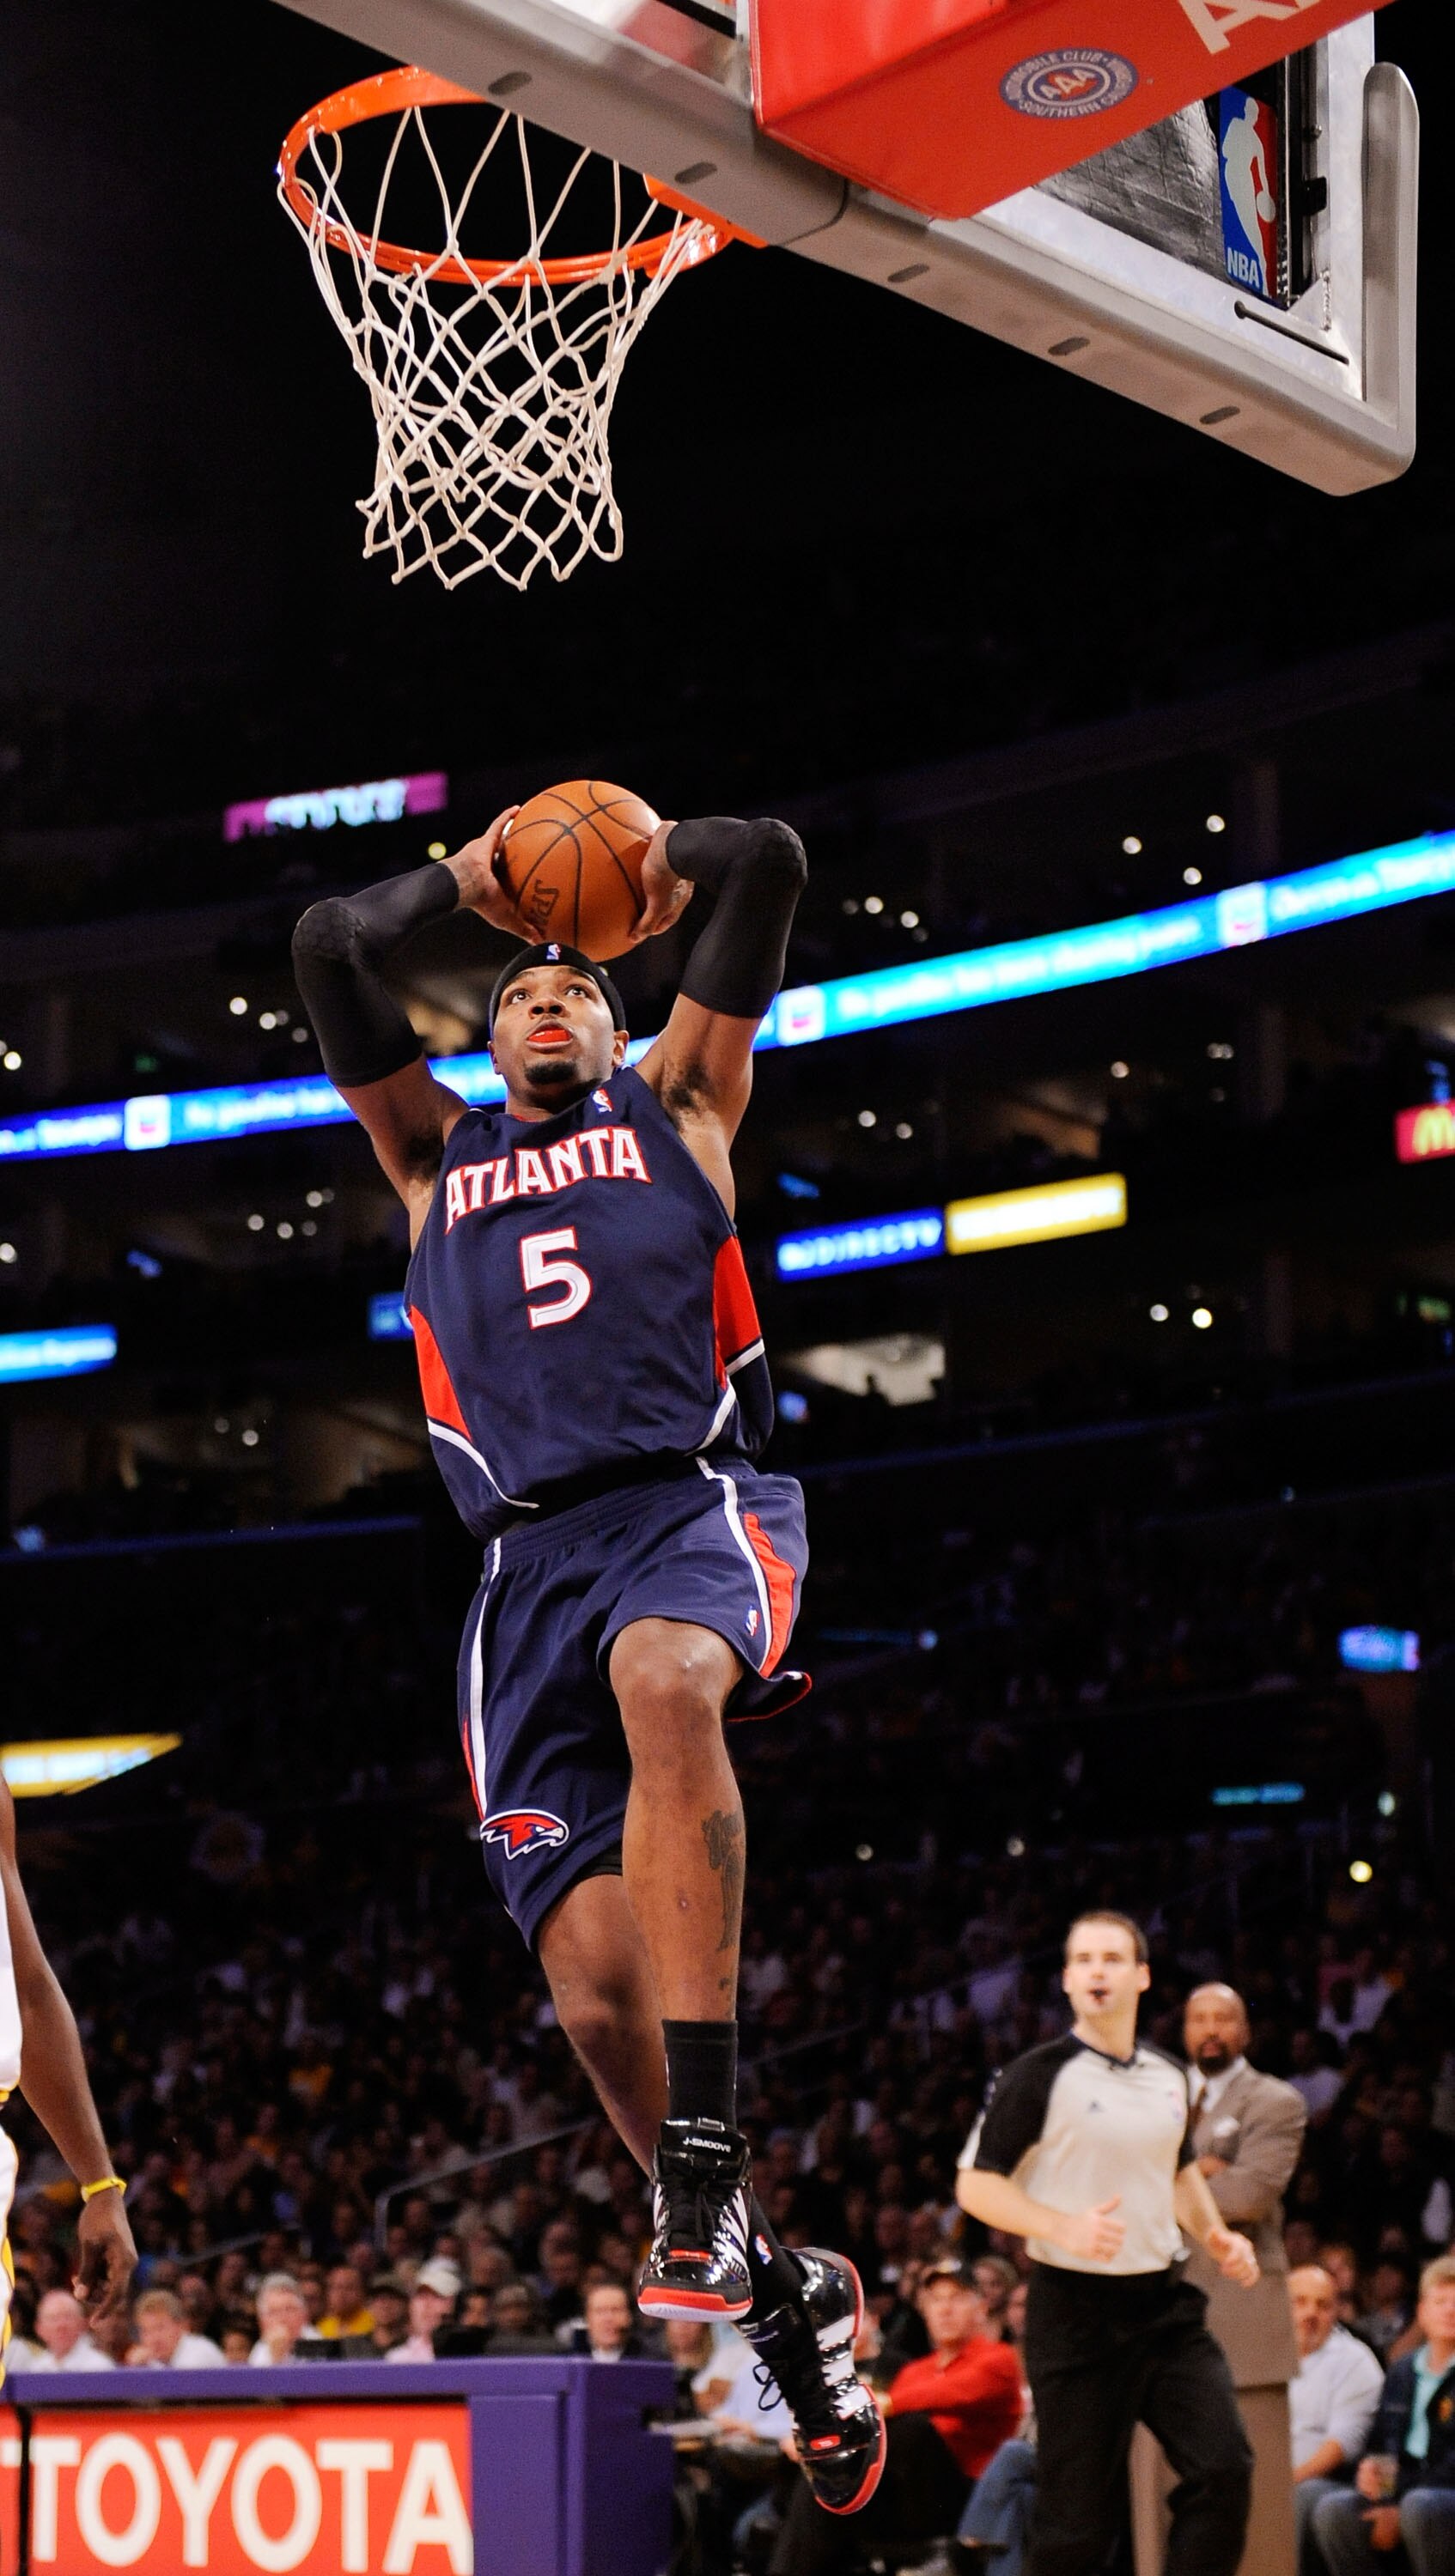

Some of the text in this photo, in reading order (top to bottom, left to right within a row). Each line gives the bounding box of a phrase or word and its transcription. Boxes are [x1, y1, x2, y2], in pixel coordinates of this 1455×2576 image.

[1039, 67, 1097, 100] AAA
[1227, 246, 1261, 287] NBA
[445, 1126, 653, 1235] ATLANTA
[520, 1225, 593, 1330] 5
[2, 2432, 475, 2575] TOYOTA
